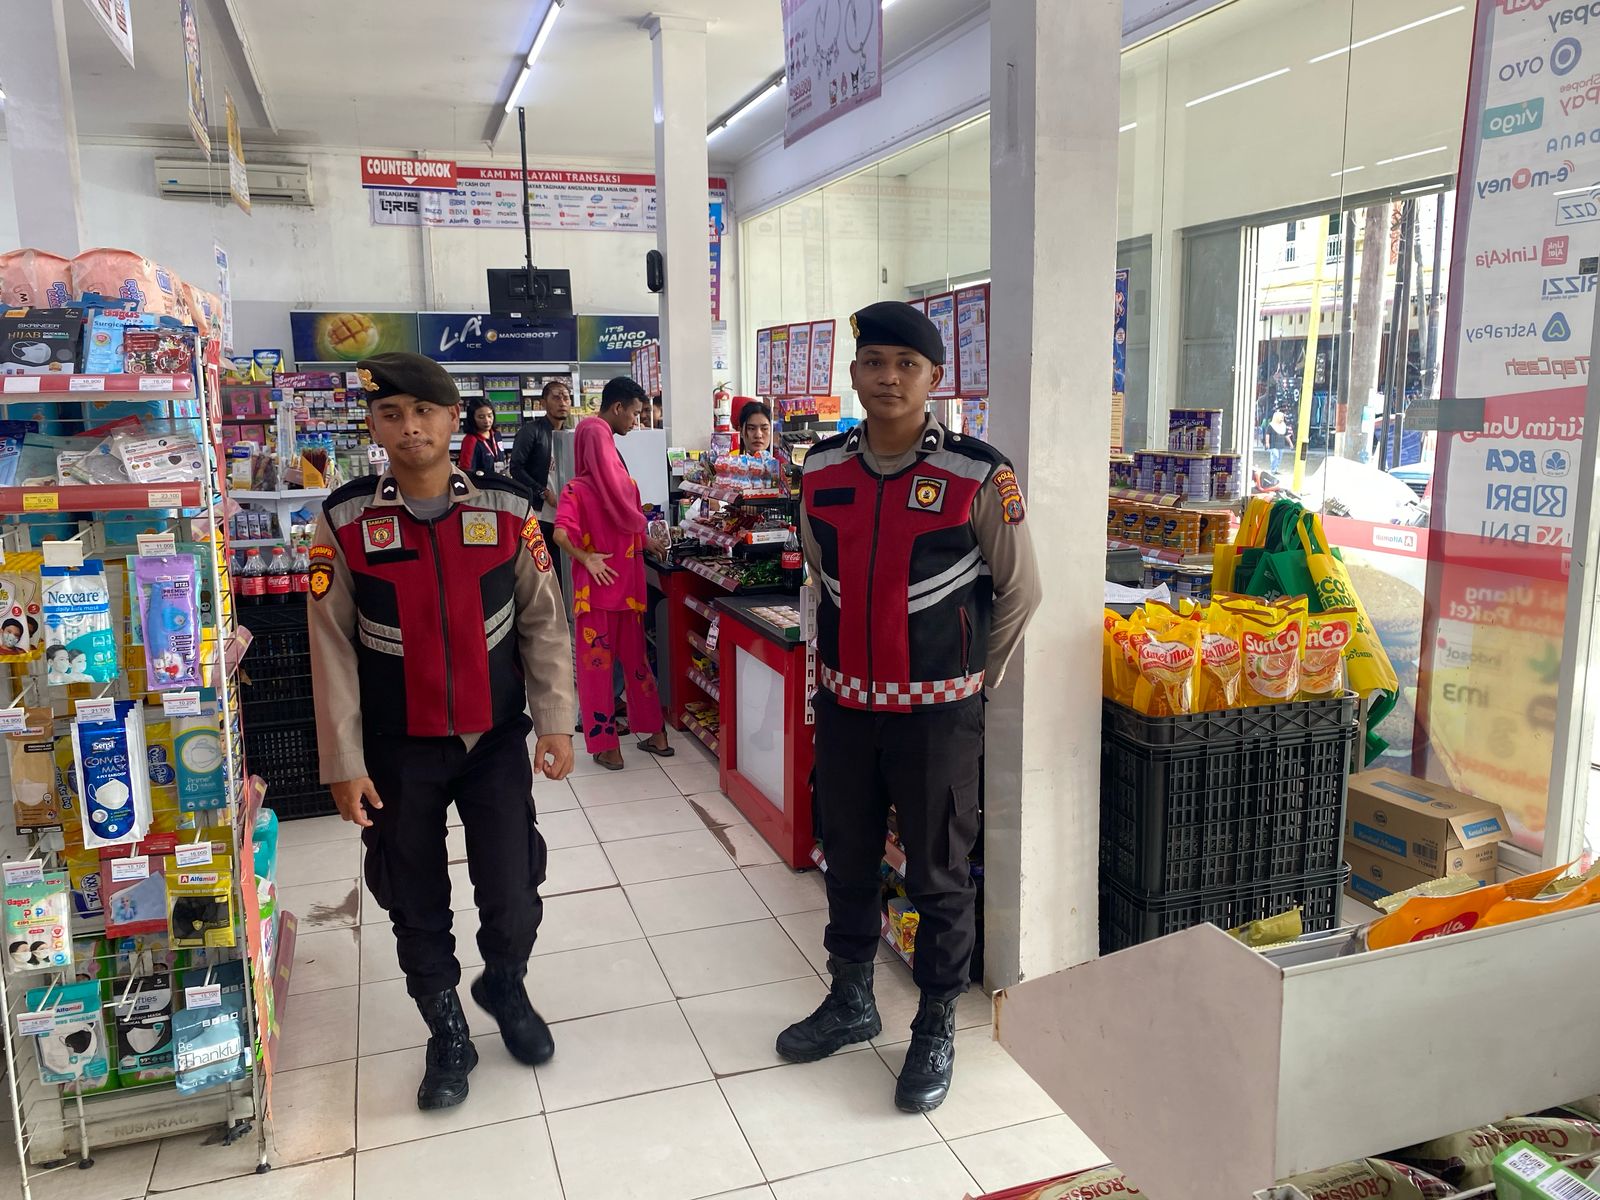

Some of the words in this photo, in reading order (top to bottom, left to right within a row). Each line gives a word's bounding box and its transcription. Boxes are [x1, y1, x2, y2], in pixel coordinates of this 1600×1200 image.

[366, 158, 413, 176] COUNTER
[414, 162, 451, 178] ROKOK
[480, 169, 506, 179] KAMI
[566, 173, 621, 183] TRANSAKSI
[8, 331, 41, 340] HIJAB
[599, 331, 646, 343] MANGO
[48, 591, 99, 606] Nexcare
[1245, 628, 1298, 654] SunCo
[1306, 626, 1344, 647] nCo
[1170, 647, 1194, 665] Mas
[84, 755, 126, 768] CONVEX
[185, 783, 199, 792] 4D
[178, 1042, 193, 1053] Be
[178, 1038, 241, 1066] Thankful
